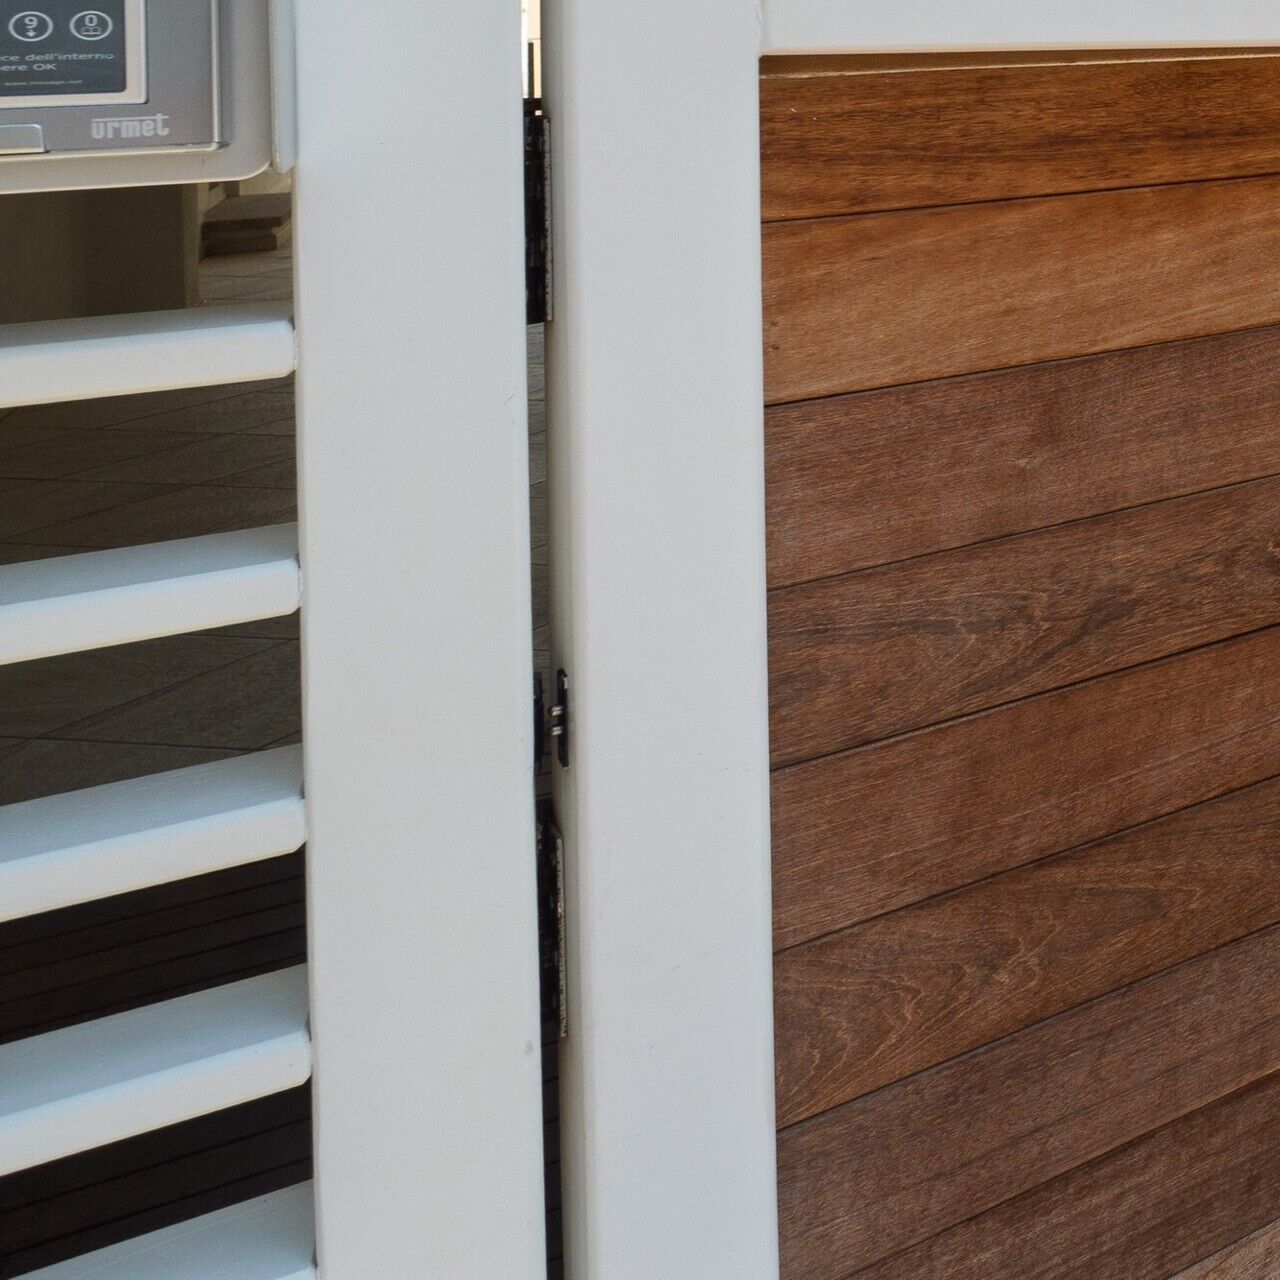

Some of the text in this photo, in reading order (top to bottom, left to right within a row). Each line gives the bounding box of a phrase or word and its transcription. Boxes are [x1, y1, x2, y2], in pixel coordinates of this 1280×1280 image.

[24, 14, 98, 29] 9 0
[25, 52, 115, 61] dell'interno
[33, 63, 57, 71] OK
[91, 113, 170, 139] urmet
